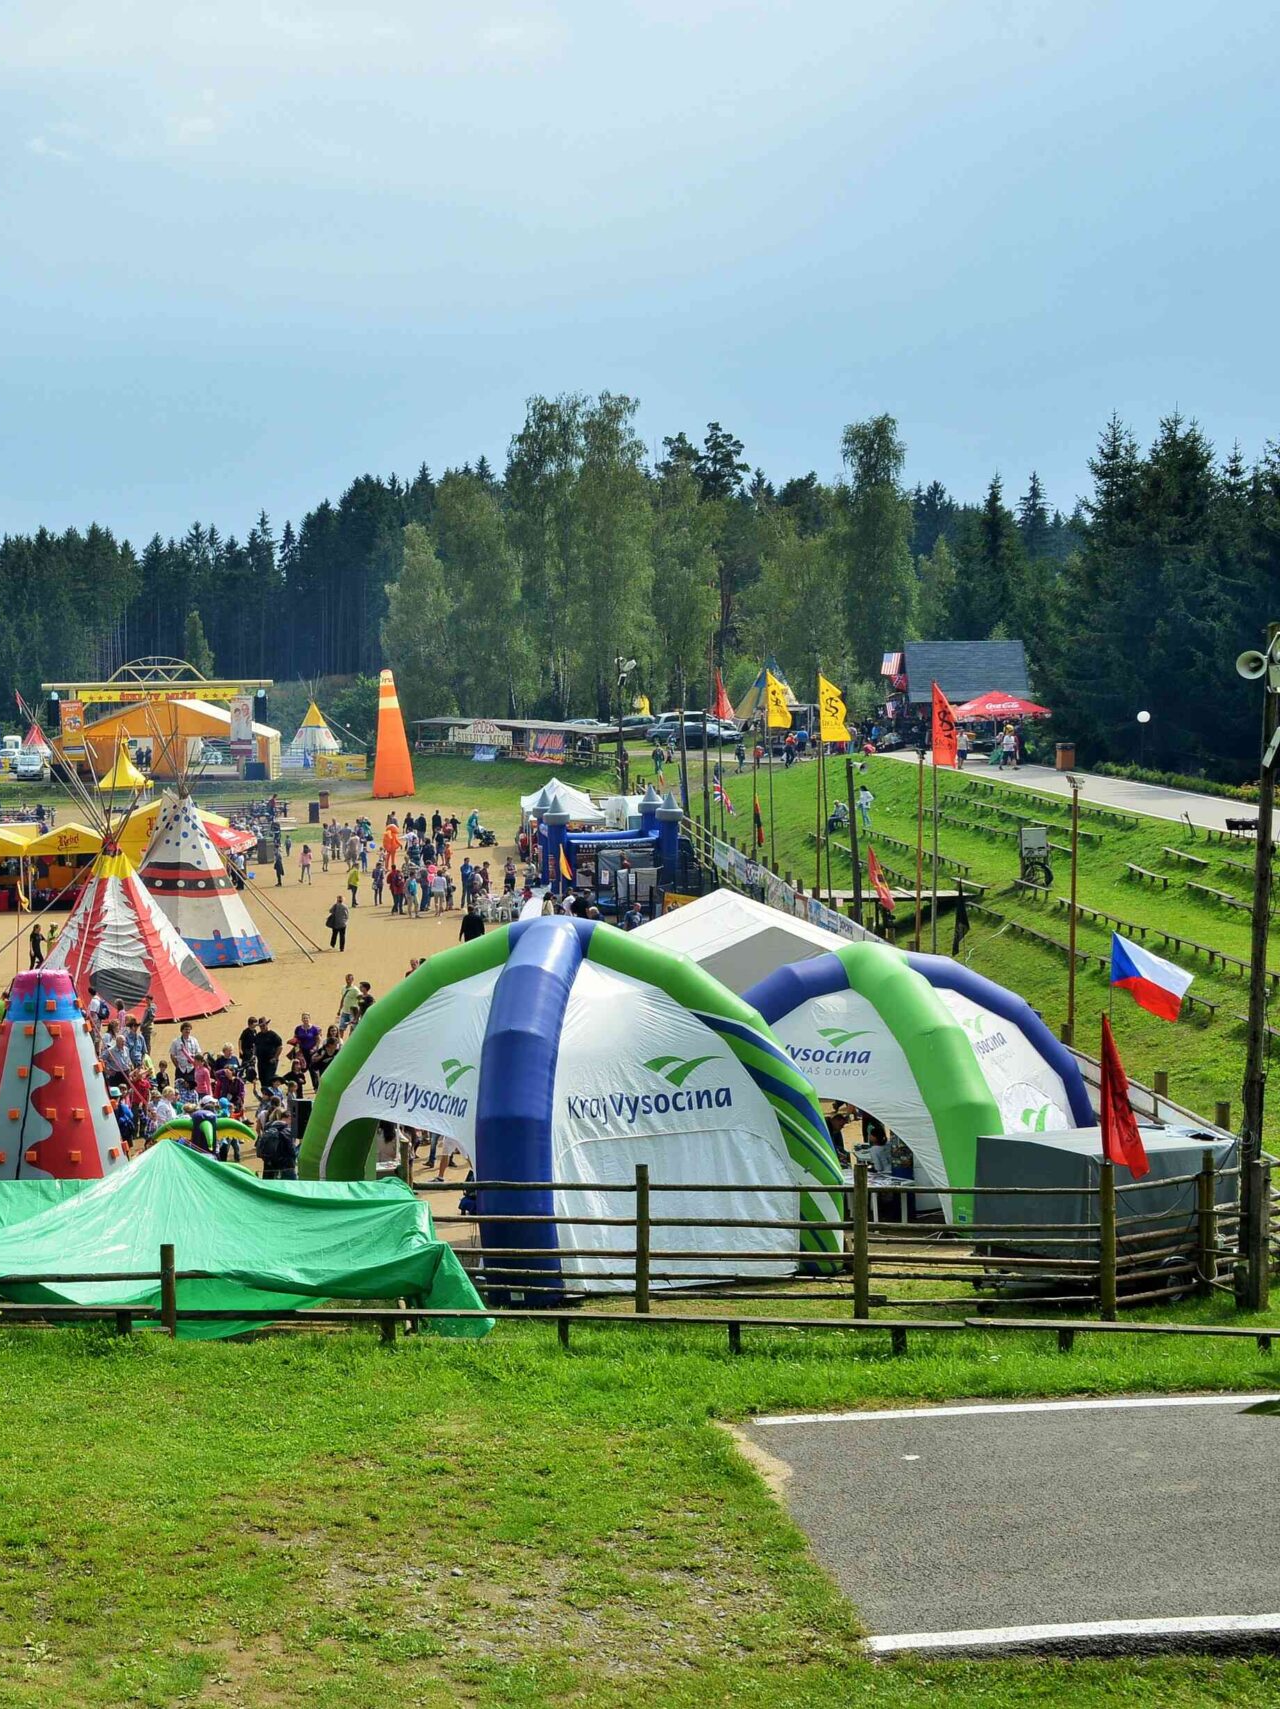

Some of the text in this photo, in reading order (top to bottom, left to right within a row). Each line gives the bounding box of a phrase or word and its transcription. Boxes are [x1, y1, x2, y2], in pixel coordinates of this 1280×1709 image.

[473, 719, 495, 734] RODEO
[824, 1067, 868, 1077] DOMOV
[366, 1074, 404, 1109] Kraj
[568, 1095, 608, 1125] Kraj
